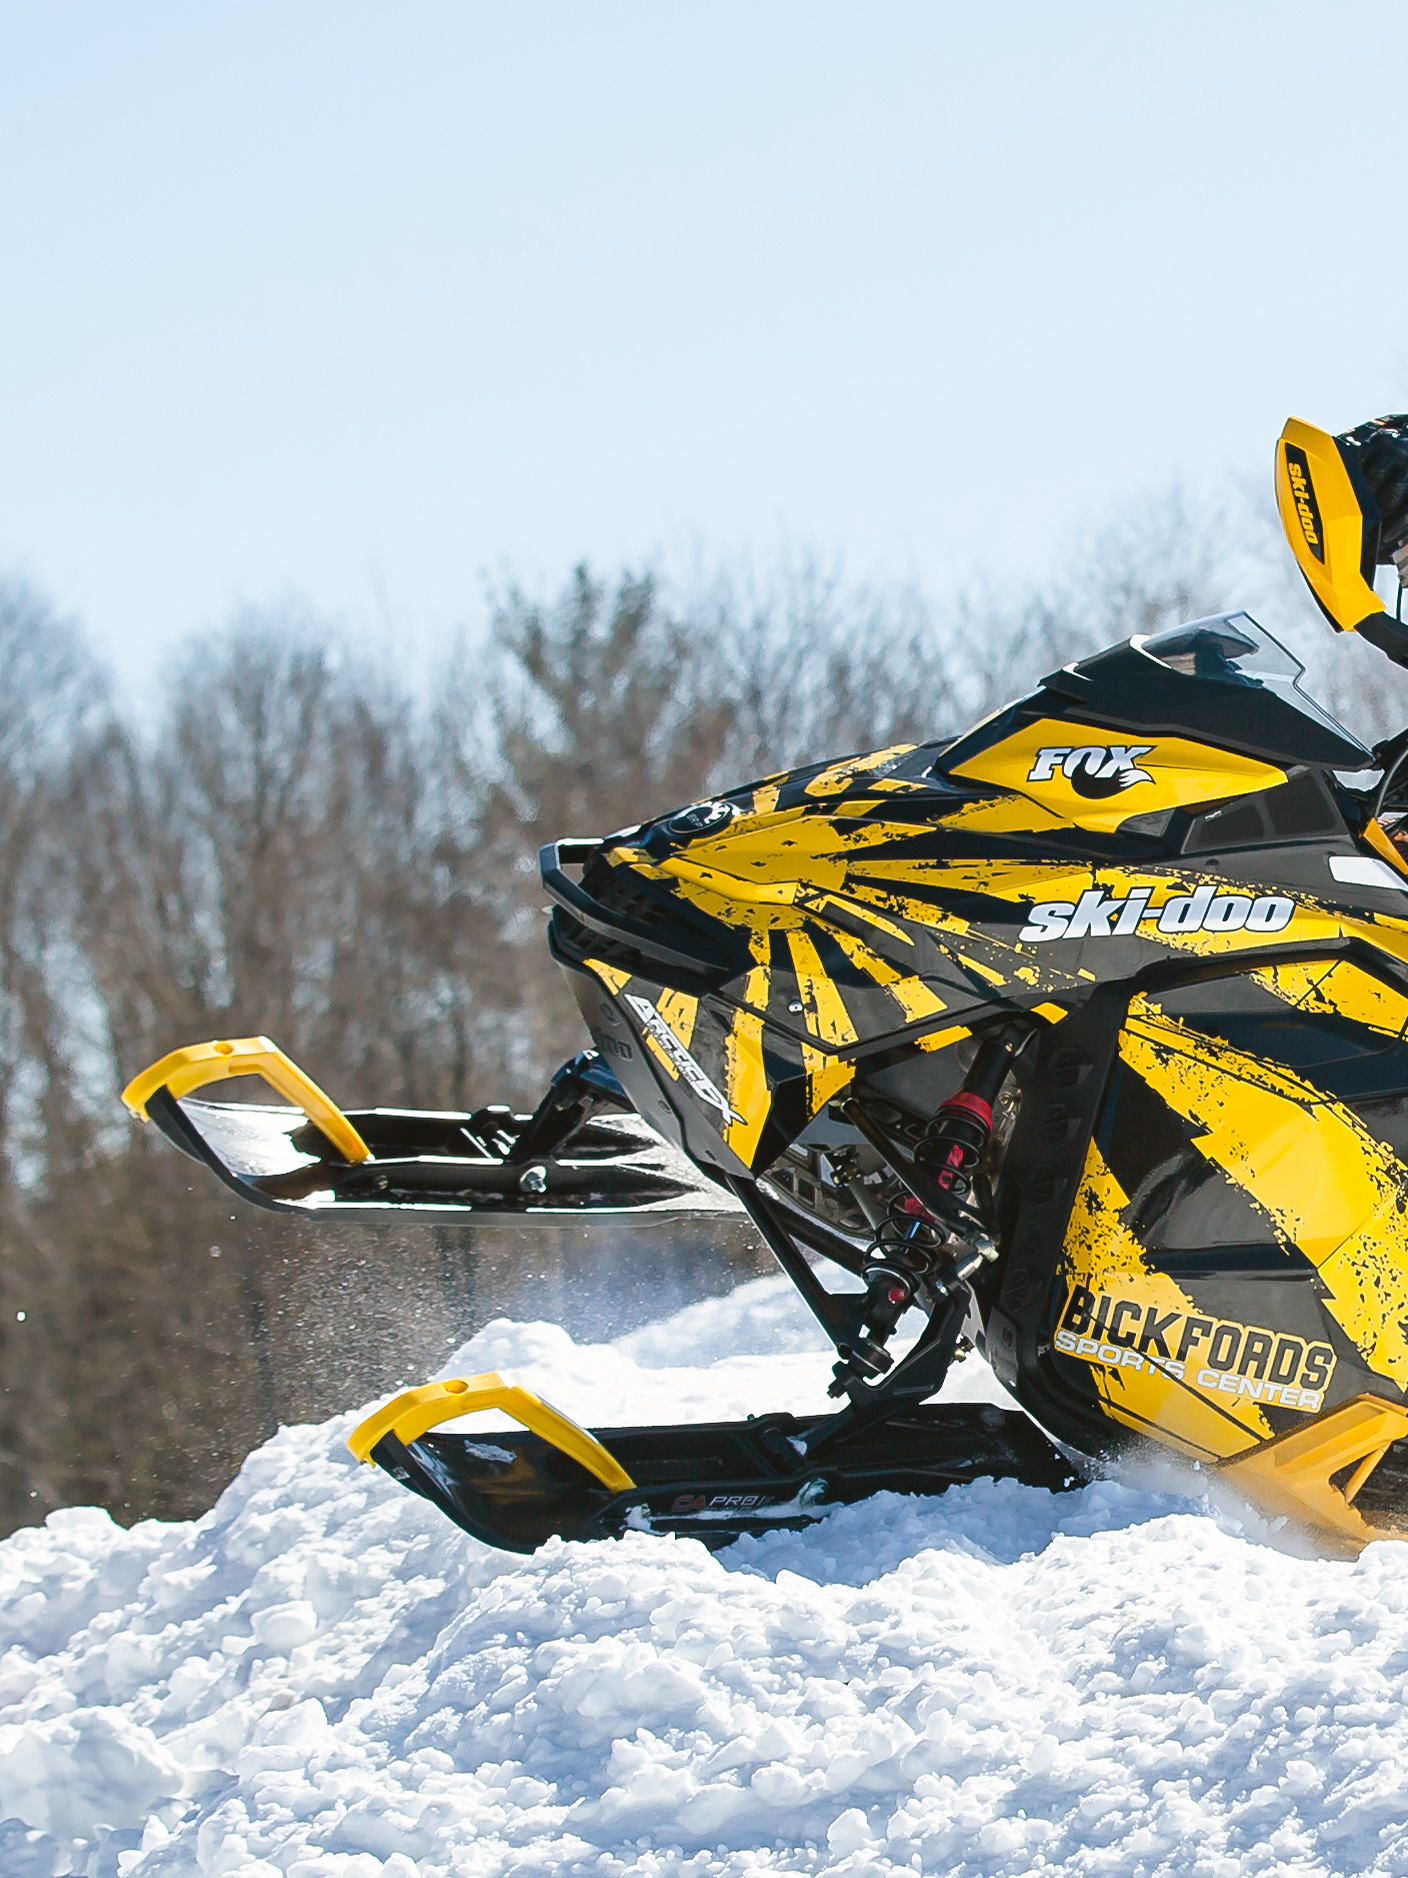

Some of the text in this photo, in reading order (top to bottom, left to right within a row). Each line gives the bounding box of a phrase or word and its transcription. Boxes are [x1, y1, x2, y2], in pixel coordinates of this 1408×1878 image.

[1288, 462, 1318, 545] ski-doo
[1026, 745, 1157, 783] FOX
[1018, 885, 1296, 943] ski-doo
[1055, 1330, 1322, 1410] SPORTS CENTER
[1060, 1284, 1336, 1391] BICKFORDS
